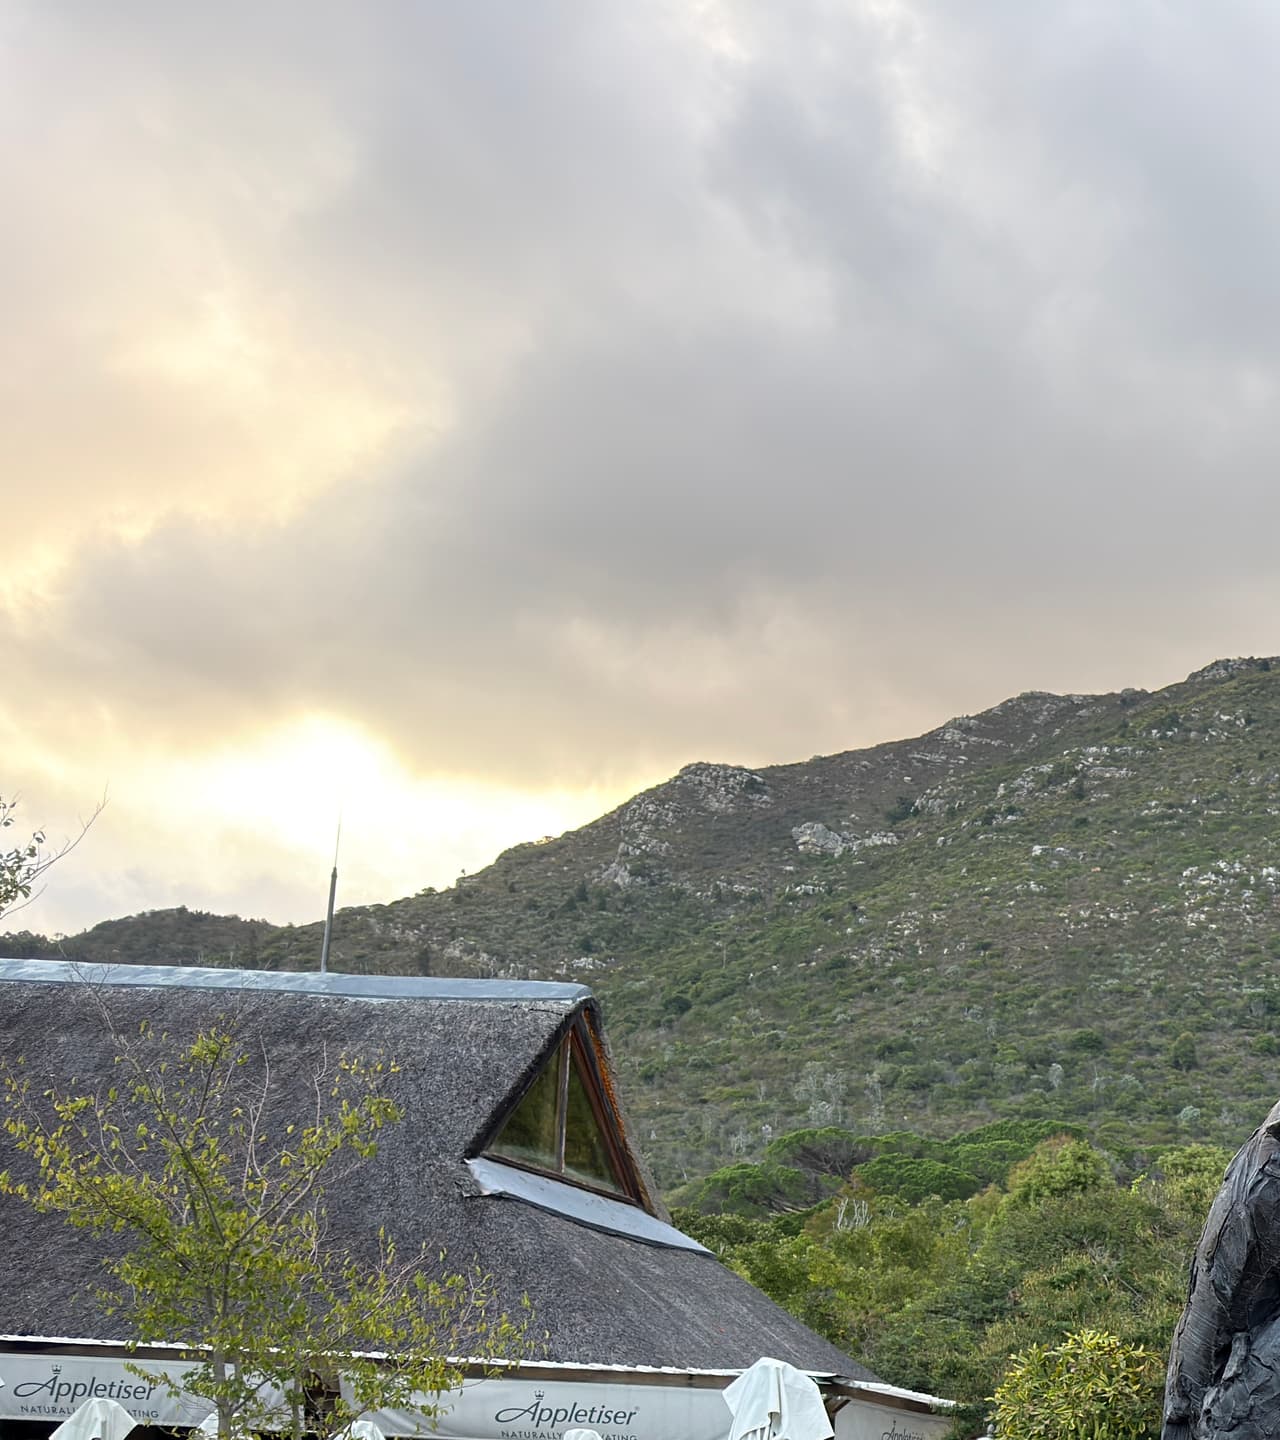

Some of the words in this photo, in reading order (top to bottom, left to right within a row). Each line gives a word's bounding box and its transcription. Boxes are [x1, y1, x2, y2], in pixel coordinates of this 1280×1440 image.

[13, 1375, 156, 1403] Appletiser
[495, 1401, 637, 1428] Appletiser
[501, 1430, 562, 1440] NATURALLY
